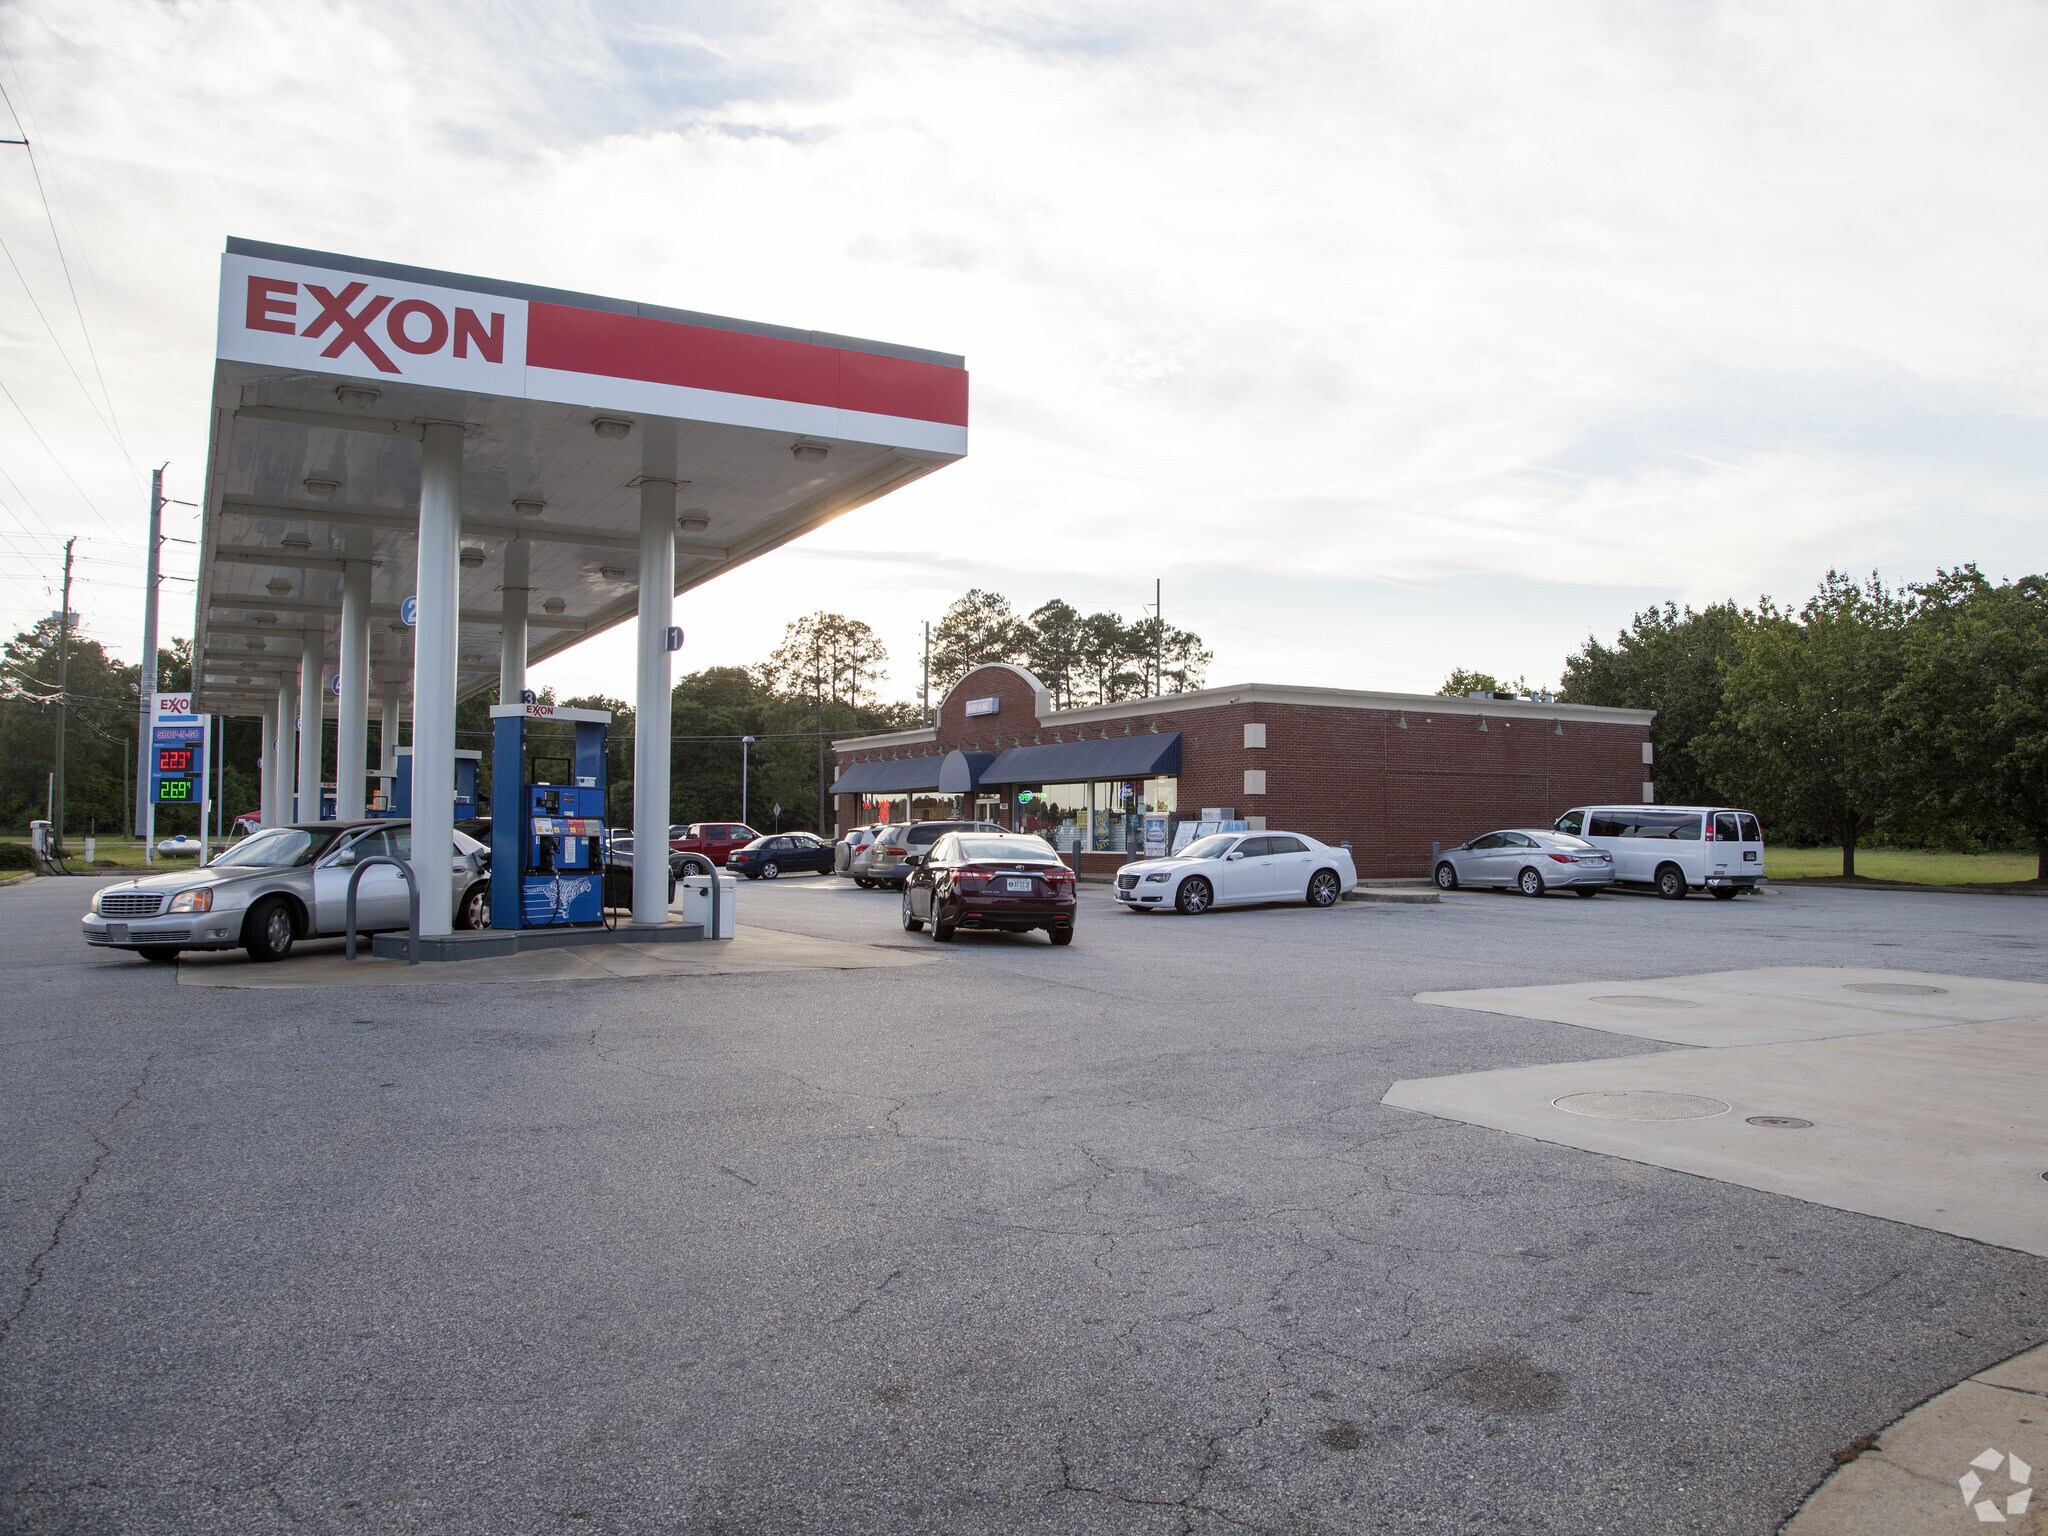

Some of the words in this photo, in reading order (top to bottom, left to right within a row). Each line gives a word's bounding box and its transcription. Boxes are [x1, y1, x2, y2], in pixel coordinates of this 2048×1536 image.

[246, 275, 505, 374] EXXON
[671, 629, 678, 649] 1
[525, 691, 533, 704] 3
[160, 697, 189, 714] EXXO
[526, 704, 554, 717] EXXON
[157, 729, 200, 740] SHOP-N-GO
